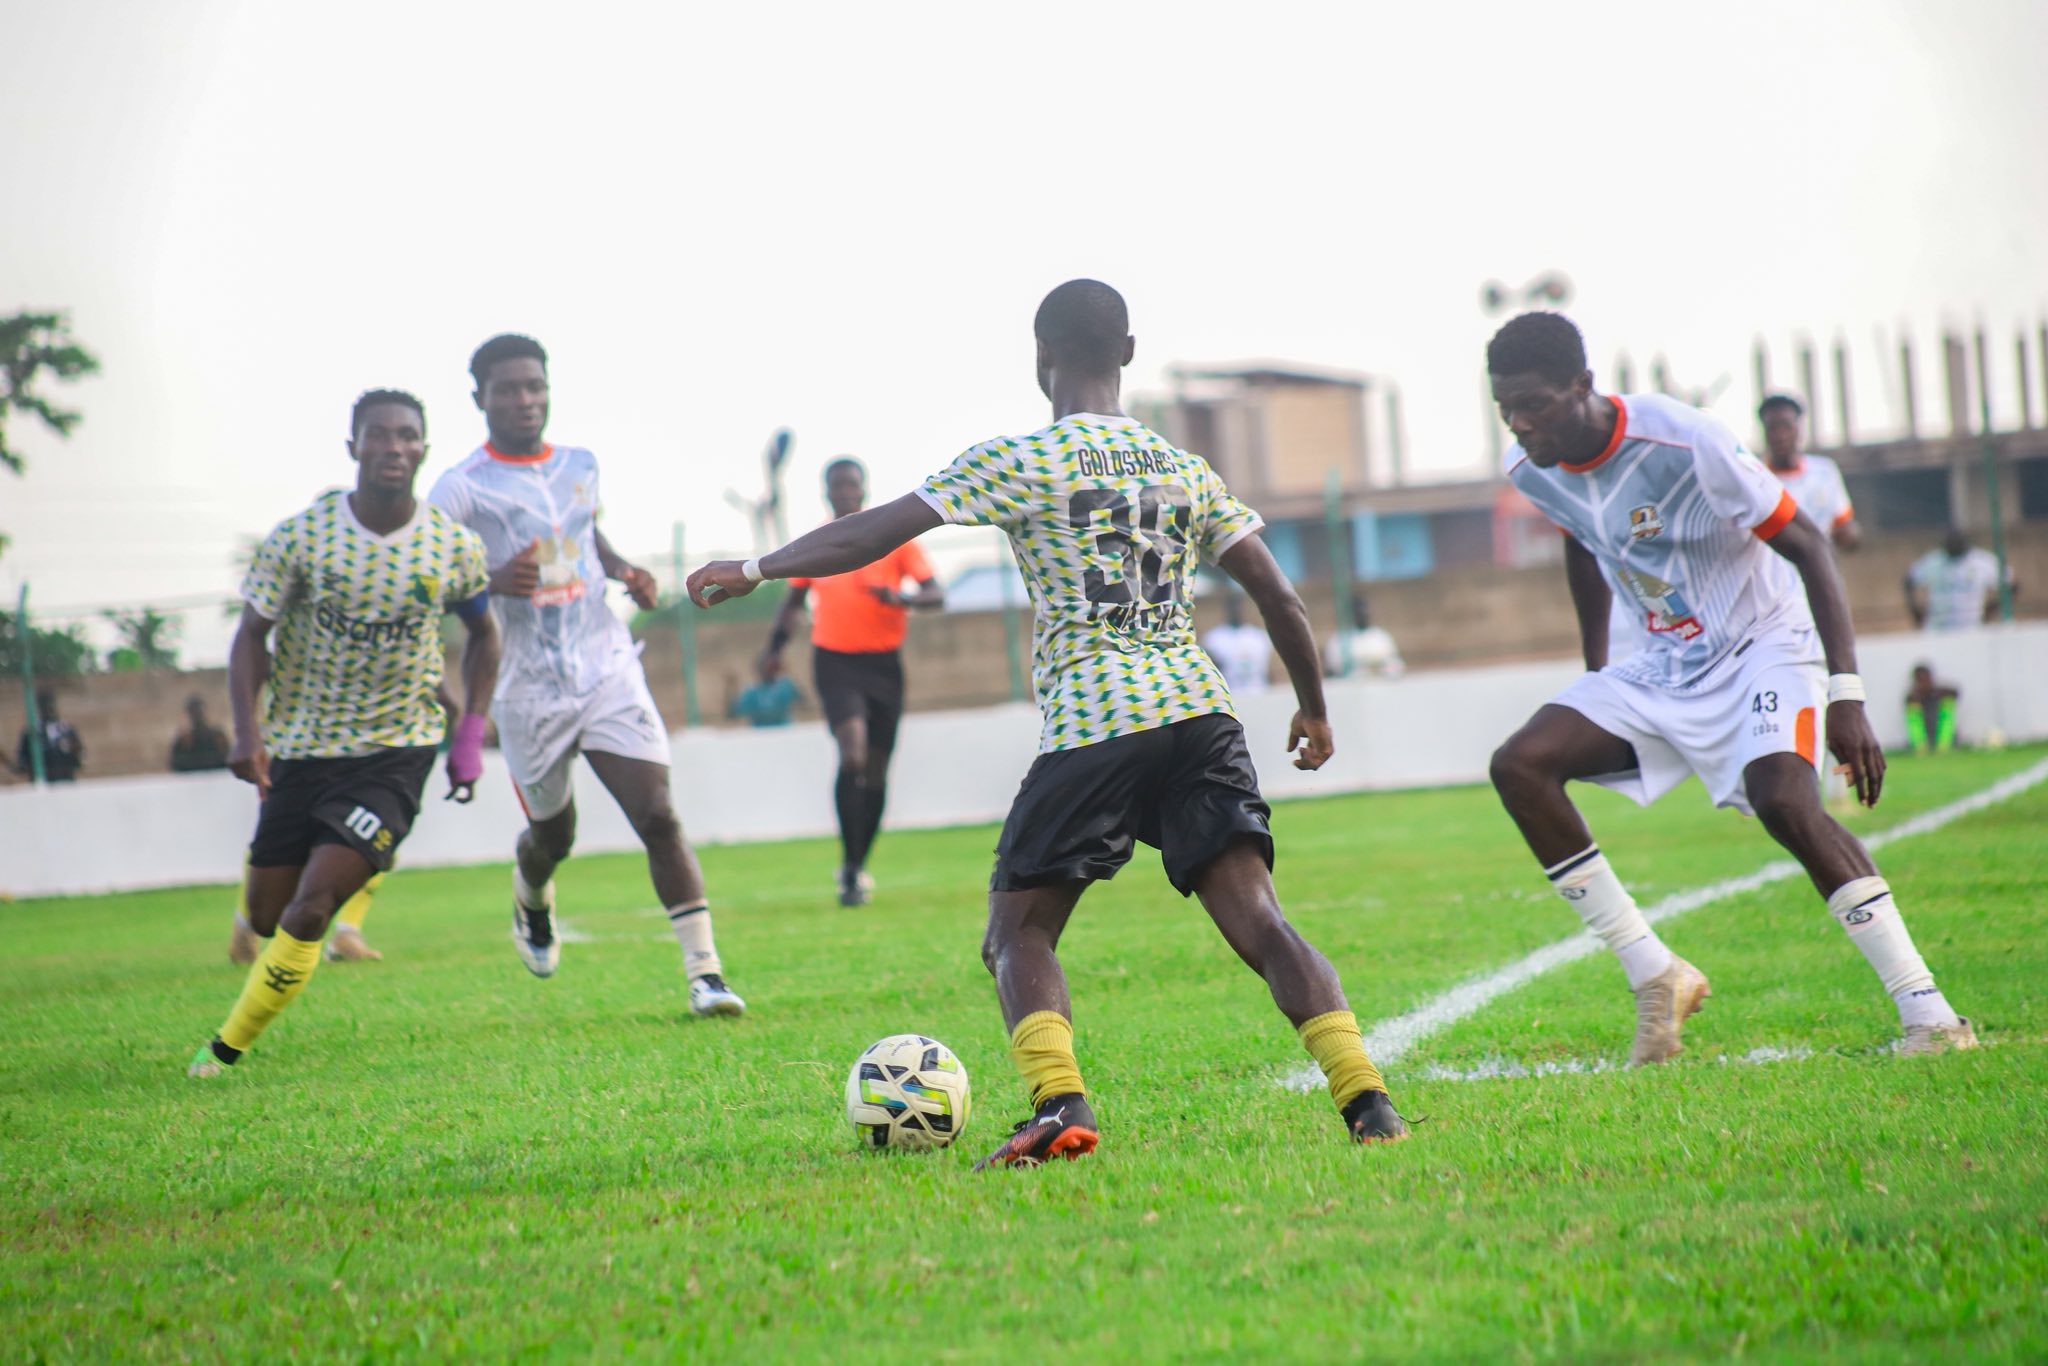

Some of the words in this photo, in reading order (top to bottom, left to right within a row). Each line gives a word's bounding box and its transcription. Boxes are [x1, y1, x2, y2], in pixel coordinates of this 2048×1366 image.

[1078, 448, 1177, 477] GOLDSTARS
[1752, 691, 1778, 714] 43
[345, 806, 382, 840] 10
